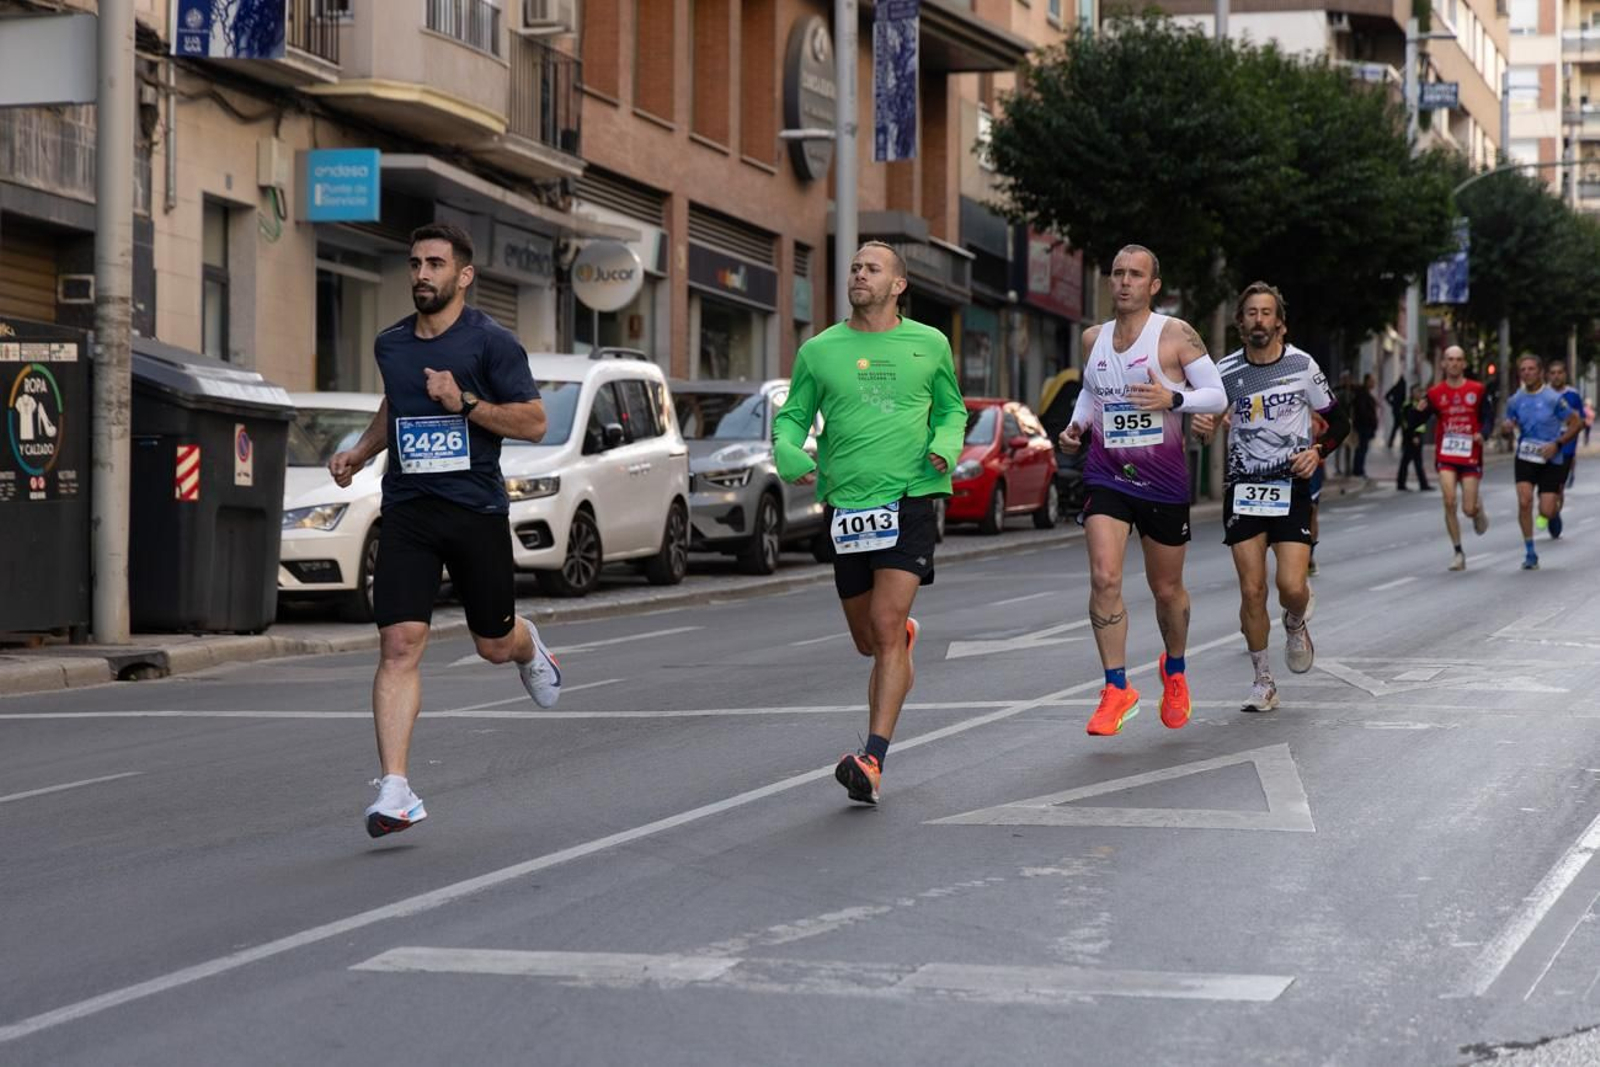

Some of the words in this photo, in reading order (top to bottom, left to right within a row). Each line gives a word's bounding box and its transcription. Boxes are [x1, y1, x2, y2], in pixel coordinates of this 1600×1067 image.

[594, 265, 634, 282] Jucar
[24, 377, 48, 394] ROPA
[1113, 413, 1152, 431] 955
[19, 445, 25, 455] Y
[25, 443, 54, 455] CALZADO
[402, 431, 463, 453] 2426
[1245, 486, 1281, 502] 375
[838, 512, 893, 535] 1013
